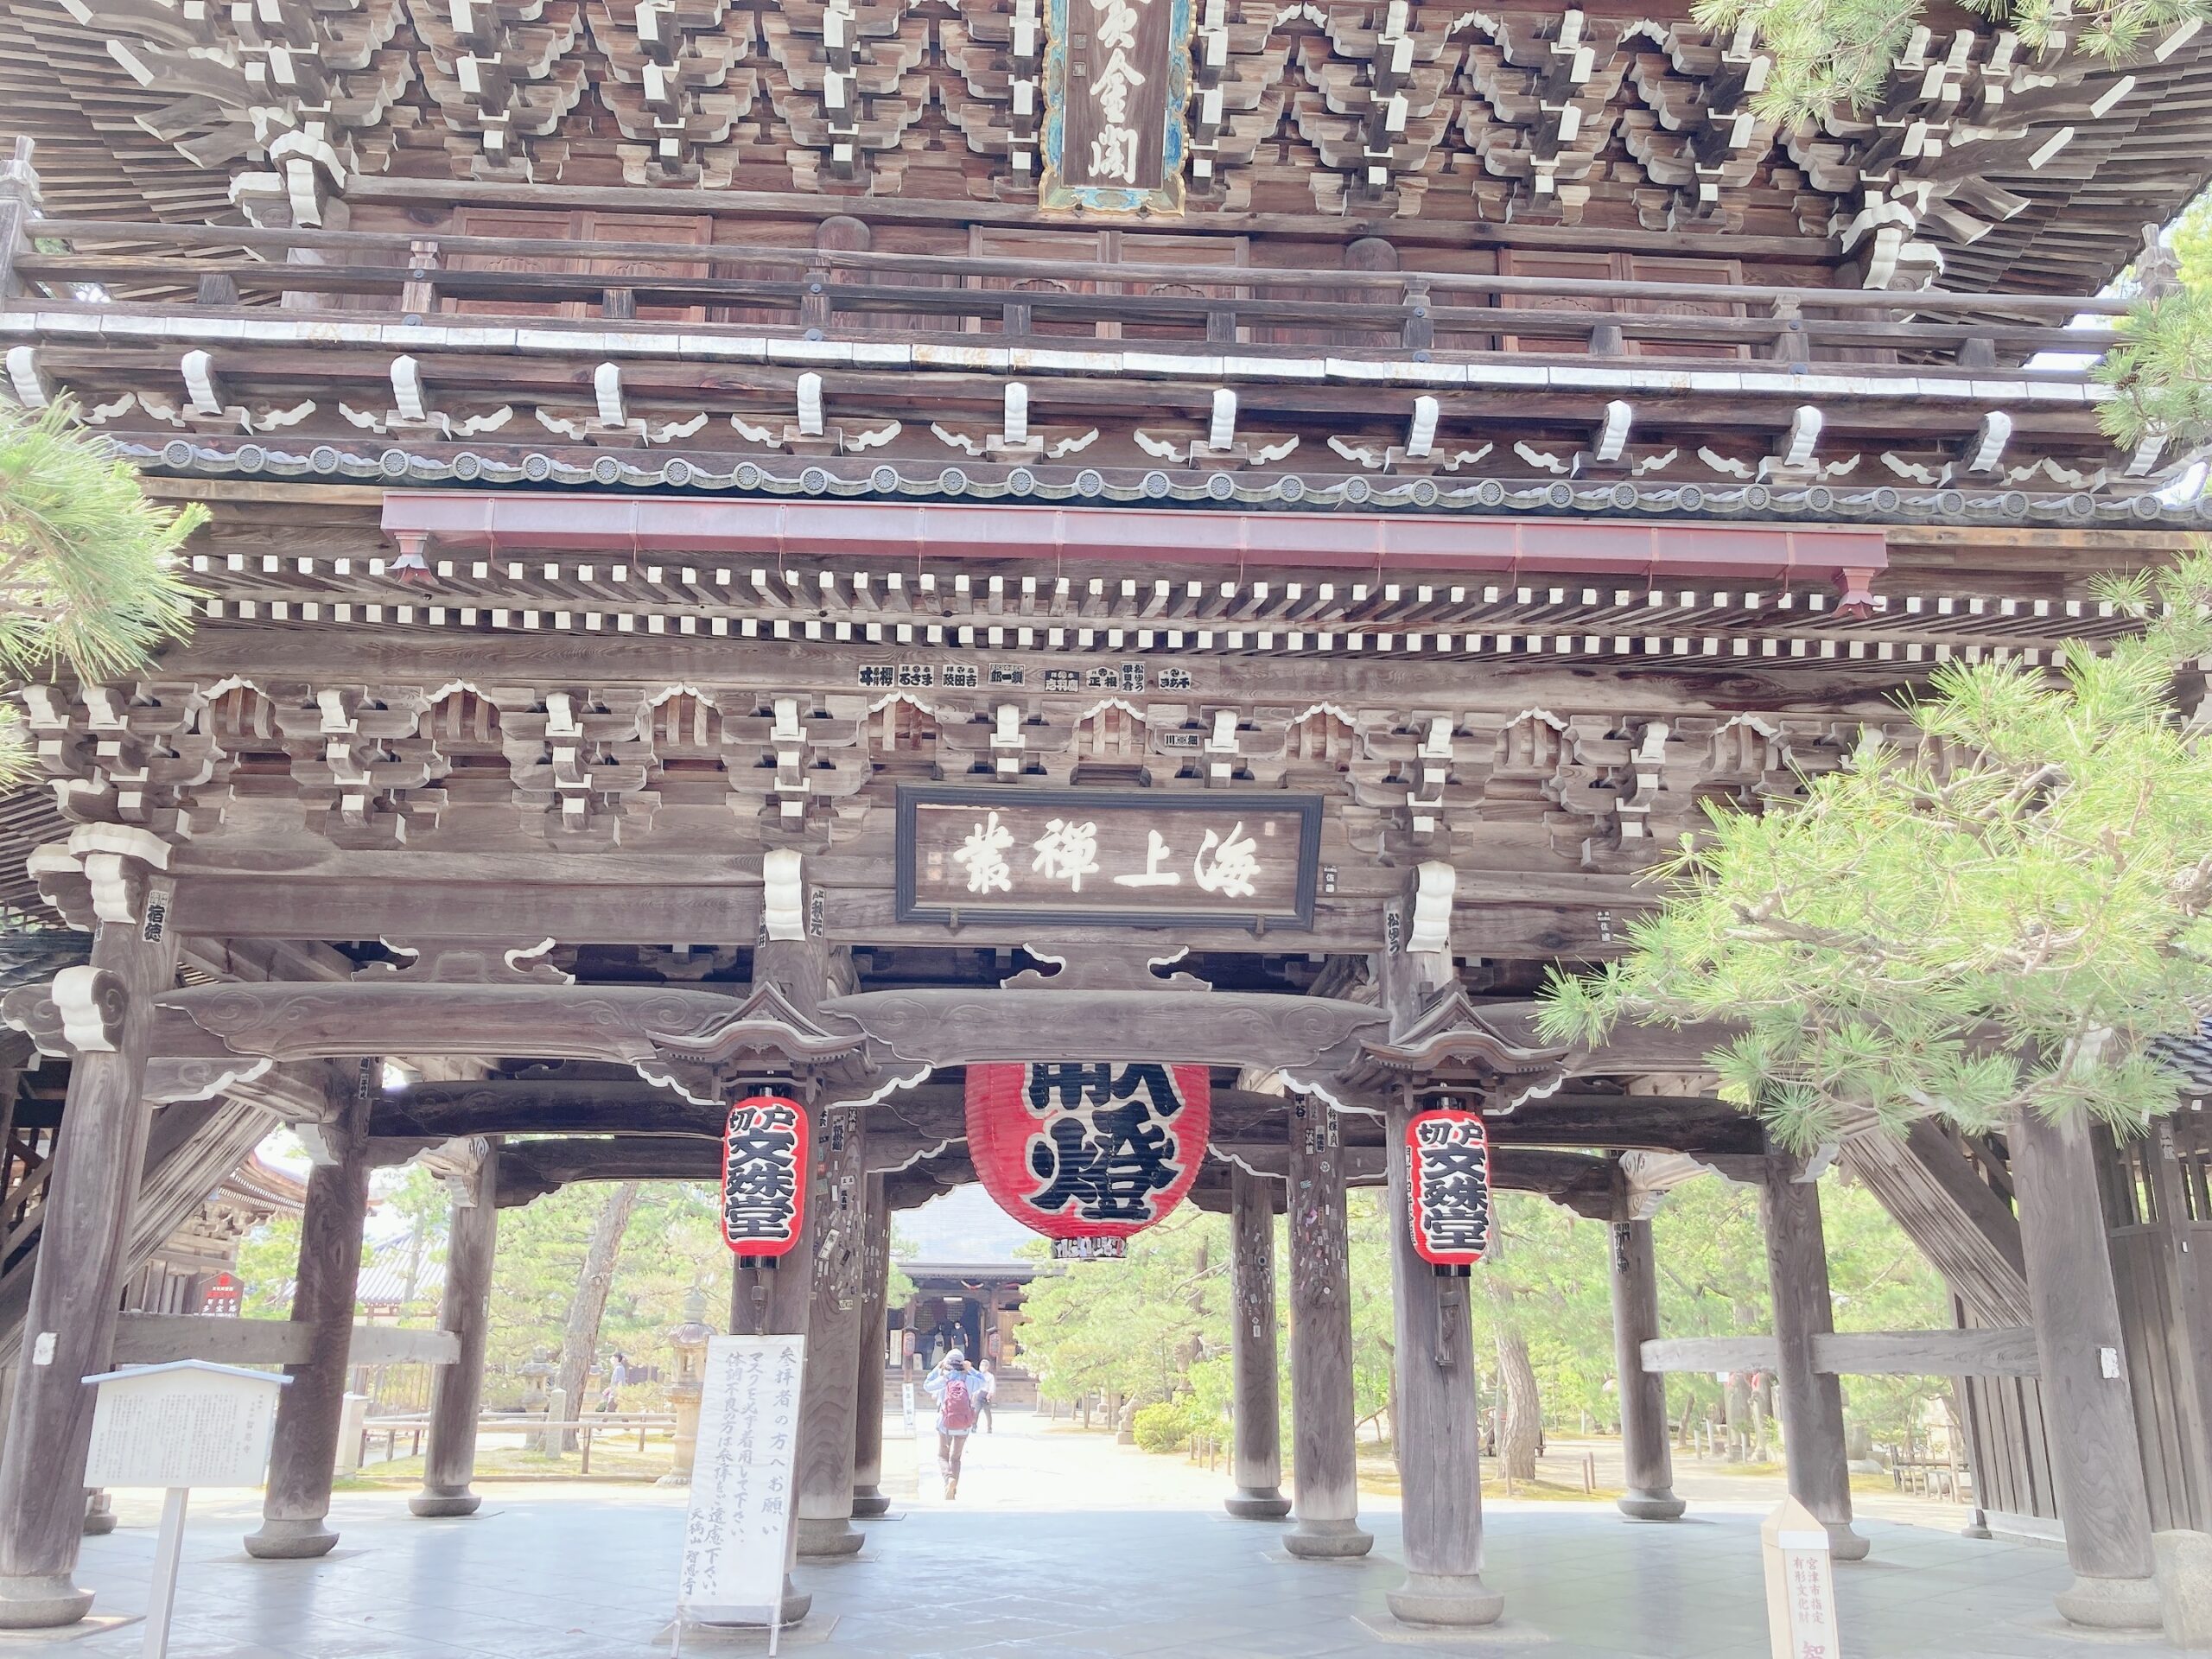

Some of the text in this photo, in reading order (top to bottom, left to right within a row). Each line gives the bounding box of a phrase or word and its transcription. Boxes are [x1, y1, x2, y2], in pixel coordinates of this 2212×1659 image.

[726, 1128, 796, 1239] 文殊堂
[1421, 1142, 1490, 1250] 文殊堂
[1806, 1556, 1825, 1624] 宮津市指定
